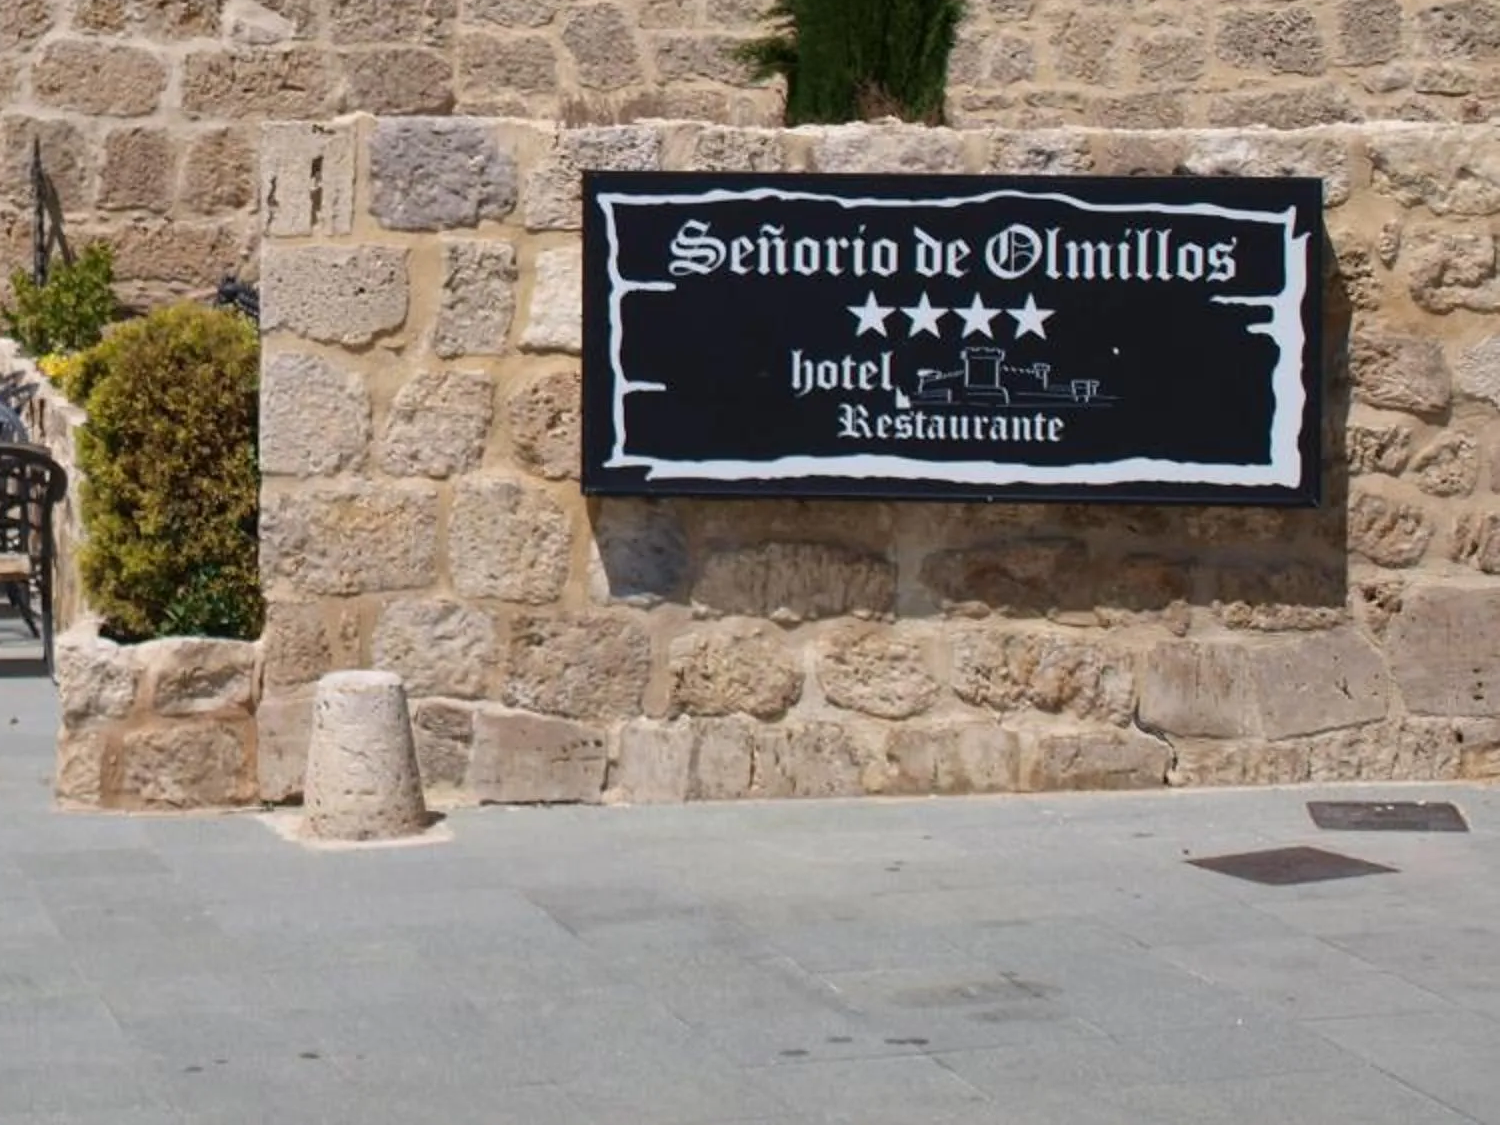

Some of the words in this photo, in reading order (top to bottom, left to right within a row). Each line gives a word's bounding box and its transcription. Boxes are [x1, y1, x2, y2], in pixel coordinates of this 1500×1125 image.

[914, 226, 971, 278] de
[984, 223, 1237, 282] Olmillos
[790, 349, 893, 395] hotel
[837, 402, 1064, 443] Restaurante
